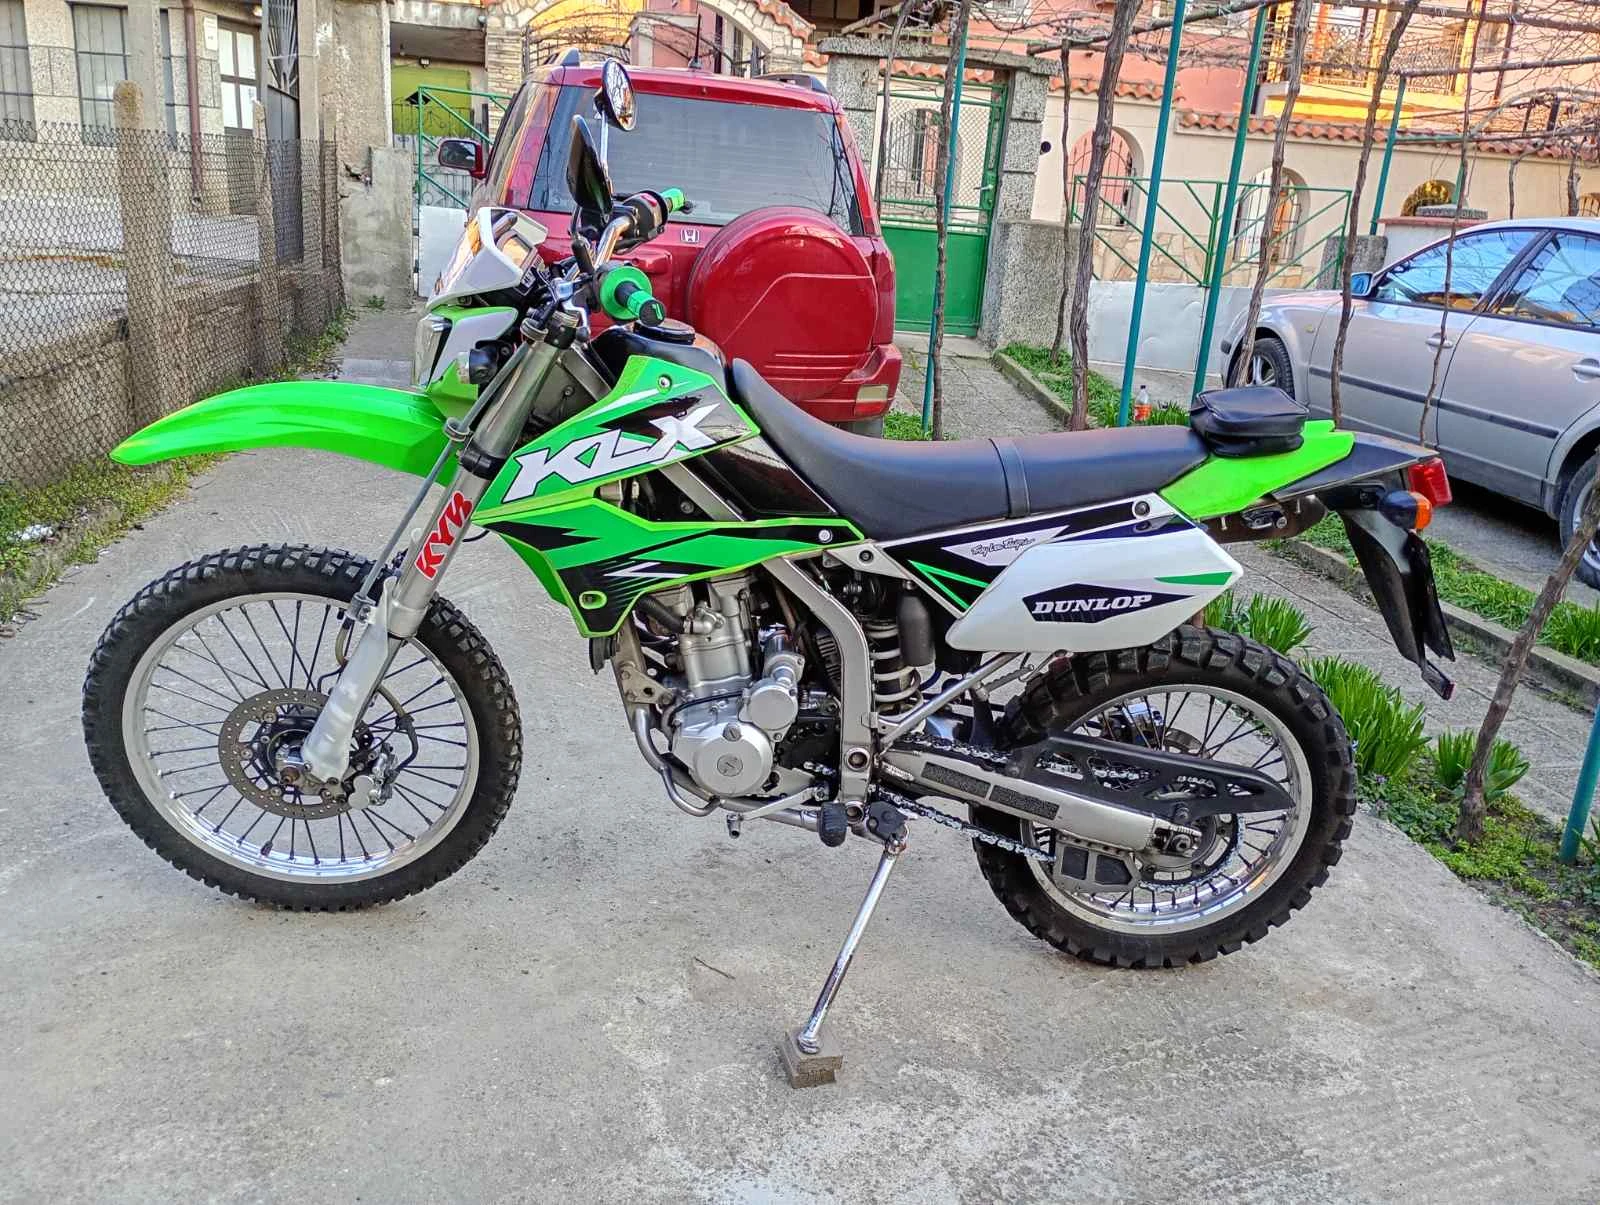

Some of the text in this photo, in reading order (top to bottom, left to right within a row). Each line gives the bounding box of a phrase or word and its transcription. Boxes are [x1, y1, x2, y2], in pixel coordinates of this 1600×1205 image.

[502, 402, 721, 504] KLX
[415, 491, 473, 580] KYB
[1032, 594, 1152, 614] DUNLOP
